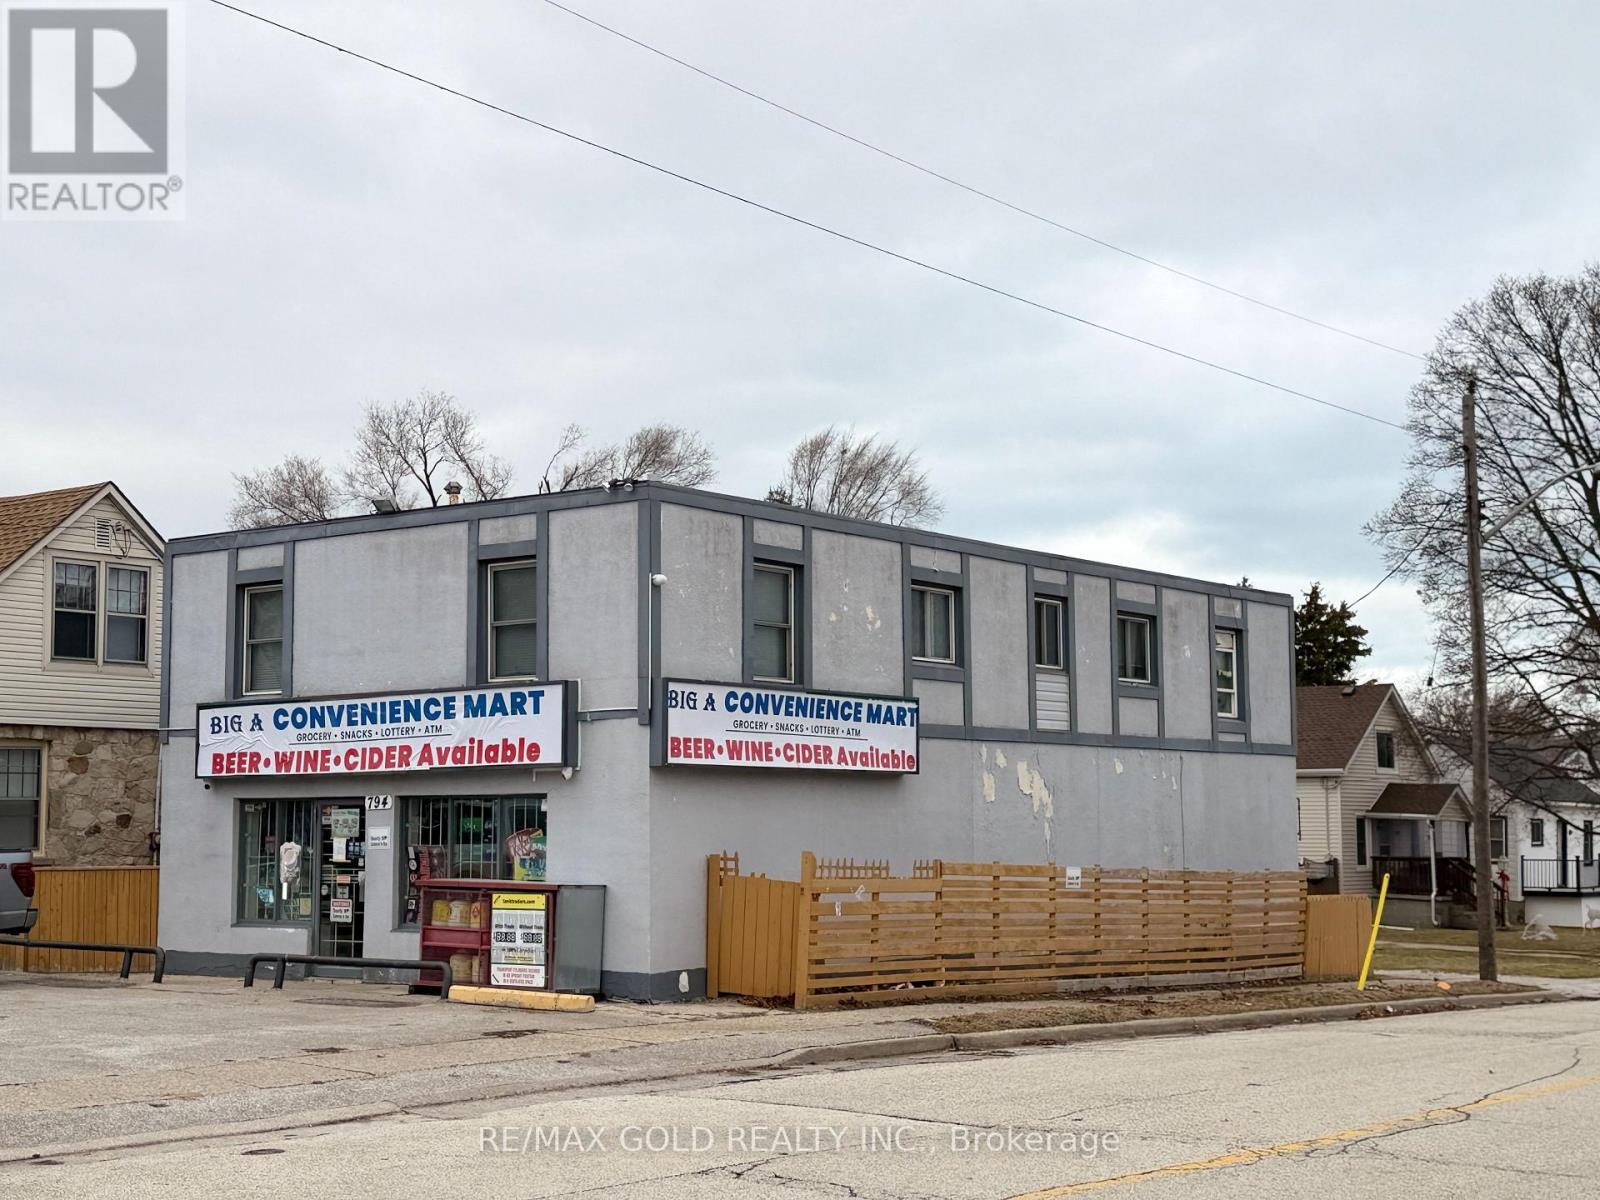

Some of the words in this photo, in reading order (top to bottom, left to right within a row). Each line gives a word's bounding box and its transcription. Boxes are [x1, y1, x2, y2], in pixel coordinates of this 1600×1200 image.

[210, 714, 243, 734] BIG
[250, 713, 264, 731] A
[273, 696, 456, 730] CONVENIENCE
[463, 690, 545, 718] MART
[668, 689, 698, 710] BIG
[703, 692, 717, 711] A
[724, 690, 863, 722] CONVENIENCE
[866, 703, 917, 727] MART
[296, 731, 332, 742] GROCERY
[340, 729, 373, 740] SNACKS
[380, 726, 416, 737] LOTTERY
[424, 724, 443, 734] ATM
[733, 719, 769, 731] GROCERY
[775, 724, 804, 734] SNACKS
[810, 725, 840, 736] LOTTERY
[846, 728, 861, 737] ATM
[211, 751, 261, 775] BEER
[274, 749, 331, 774] WINE
[344, 744, 413, 771] CIDER
[416, 736, 541, 767] Available
[670, 736, 716, 759] BEER
[725, 739, 774, 762] WINE
[783, 743, 833, 765] CIDER
[837, 745, 916, 770] Available
[367, 796, 388, 809] 794
